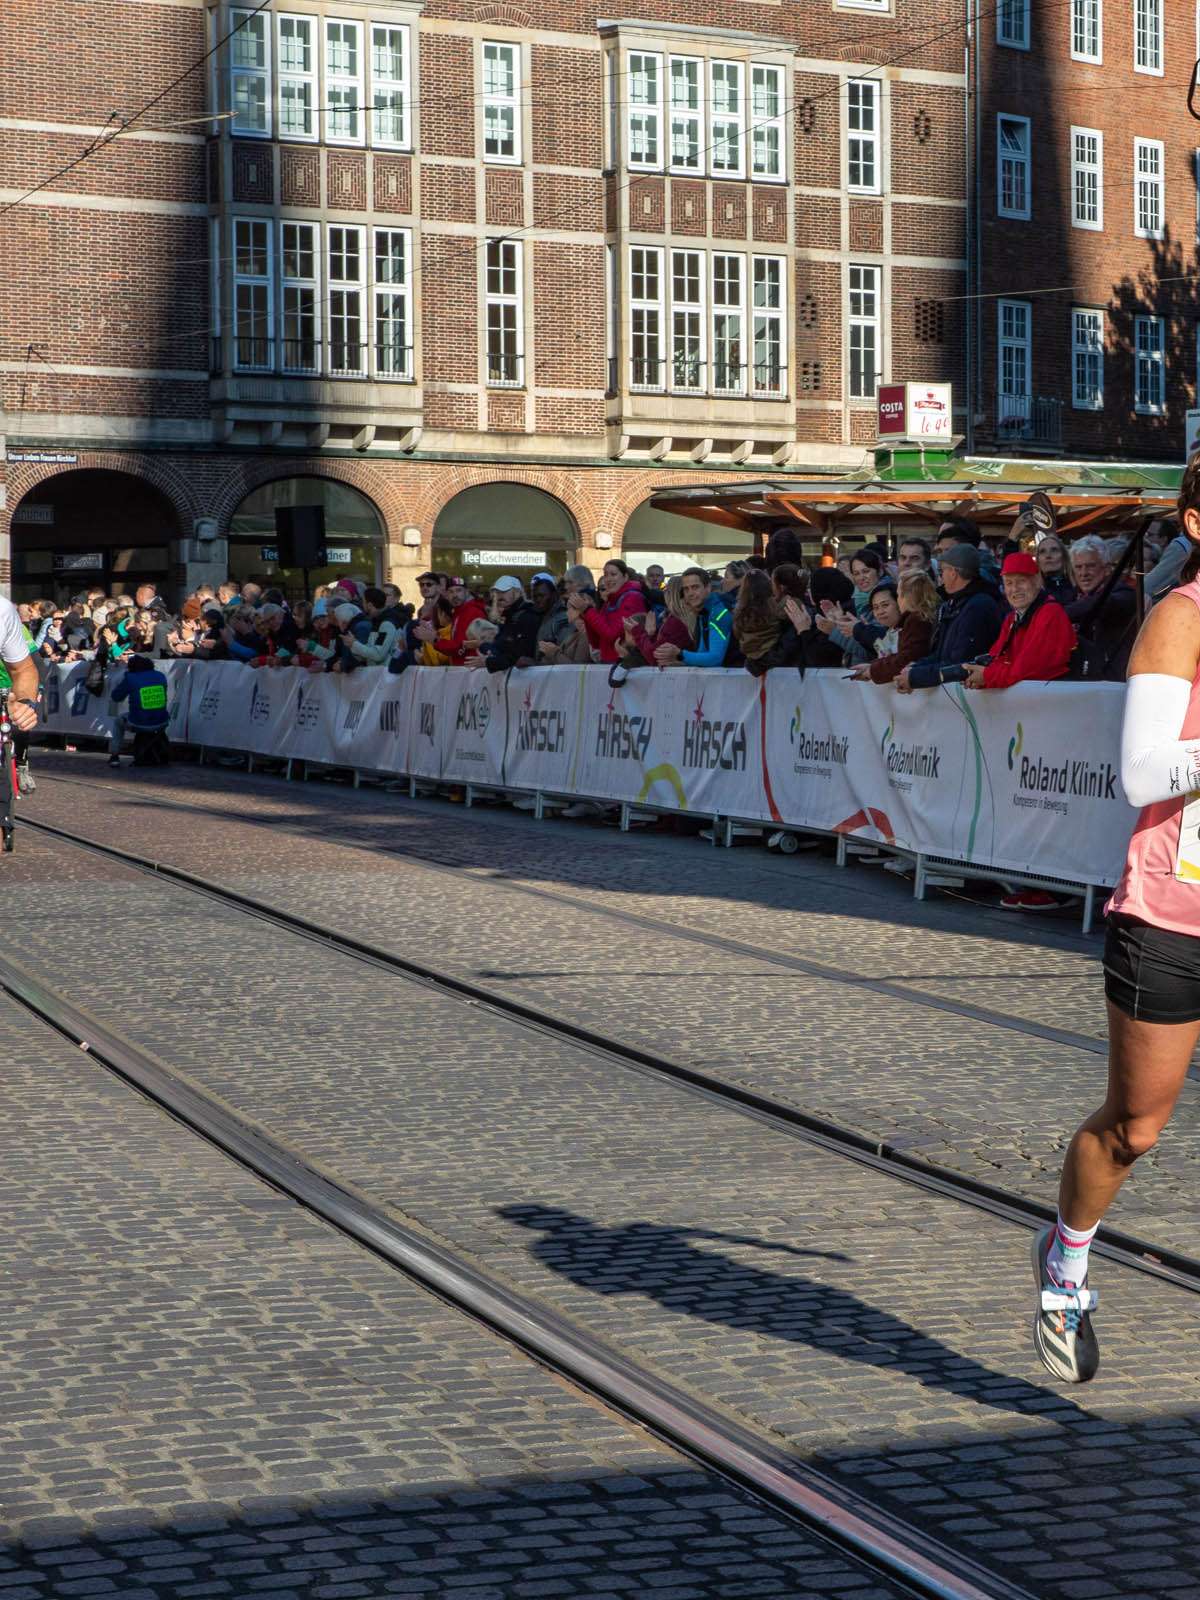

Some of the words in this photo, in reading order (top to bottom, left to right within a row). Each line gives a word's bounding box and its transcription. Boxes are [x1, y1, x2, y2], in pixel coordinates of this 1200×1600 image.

[880, 402, 904, 413] COSTA
[263, 549, 279, 560] Tee
[463, 552, 480, 563] Tee
[482, 551, 545, 564] Gschwendner
[515, 710, 567, 753] HIRSCH
[595, 712, 653, 762] HIRSCH
[683, 719, 747, 771] HIRSCH
[799, 731, 829, 762] Roland
[886, 741, 914, 777] Roland
[1019, 756, 1068, 793] Roland
[1069, 760, 1117, 800] Klinik
